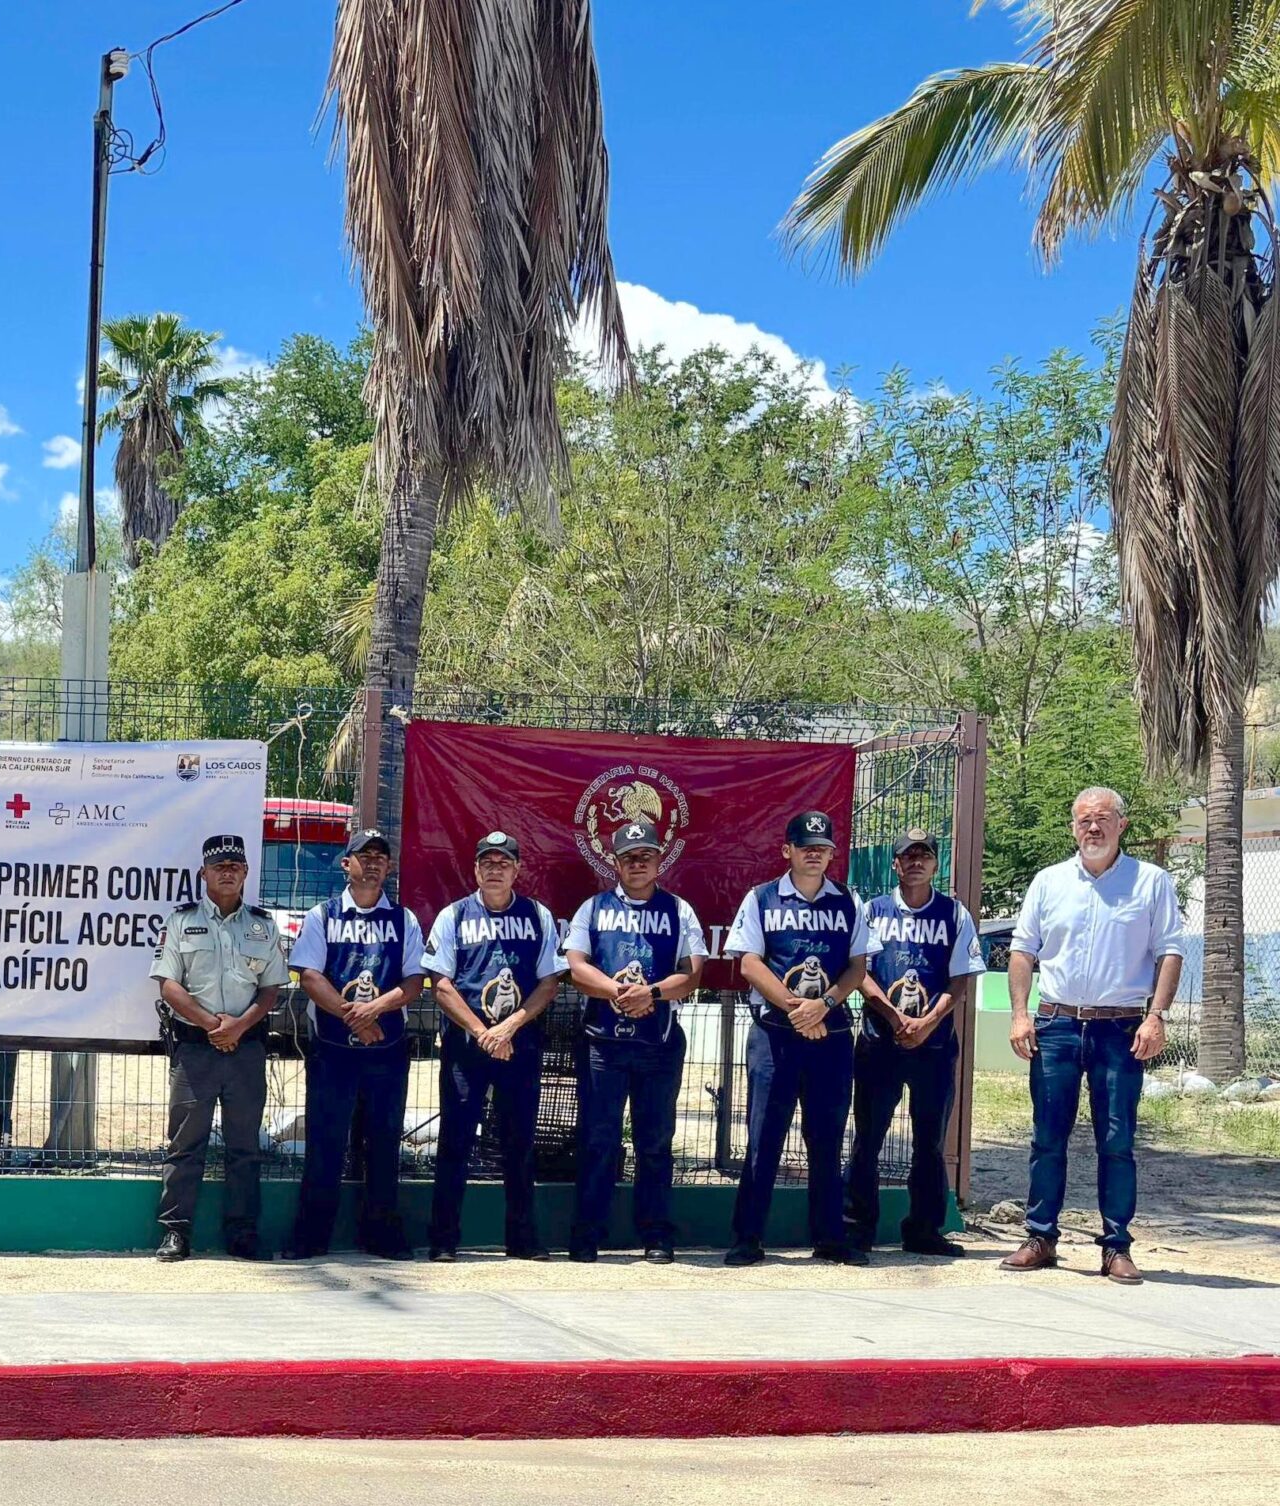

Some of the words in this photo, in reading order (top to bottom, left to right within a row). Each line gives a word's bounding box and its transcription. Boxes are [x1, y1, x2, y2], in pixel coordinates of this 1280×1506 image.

[8, 763, 54, 772] CALIFORNIA
[206, 762, 226, 770] LOS
[228, 762, 262, 770] CABOS
[638, 766, 659, 779] DE
[659, 775, 690, 828] MARINA
[77, 804, 126, 821] AMC
[575, 834, 616, 880] ARMADA
[657, 838, 686, 877] EXICO
[327, 917, 398, 944] MARINA
[460, 916, 536, 945] MARINA
[597, 909, 672, 936] MARINA
[764, 909, 848, 932] MARINA
